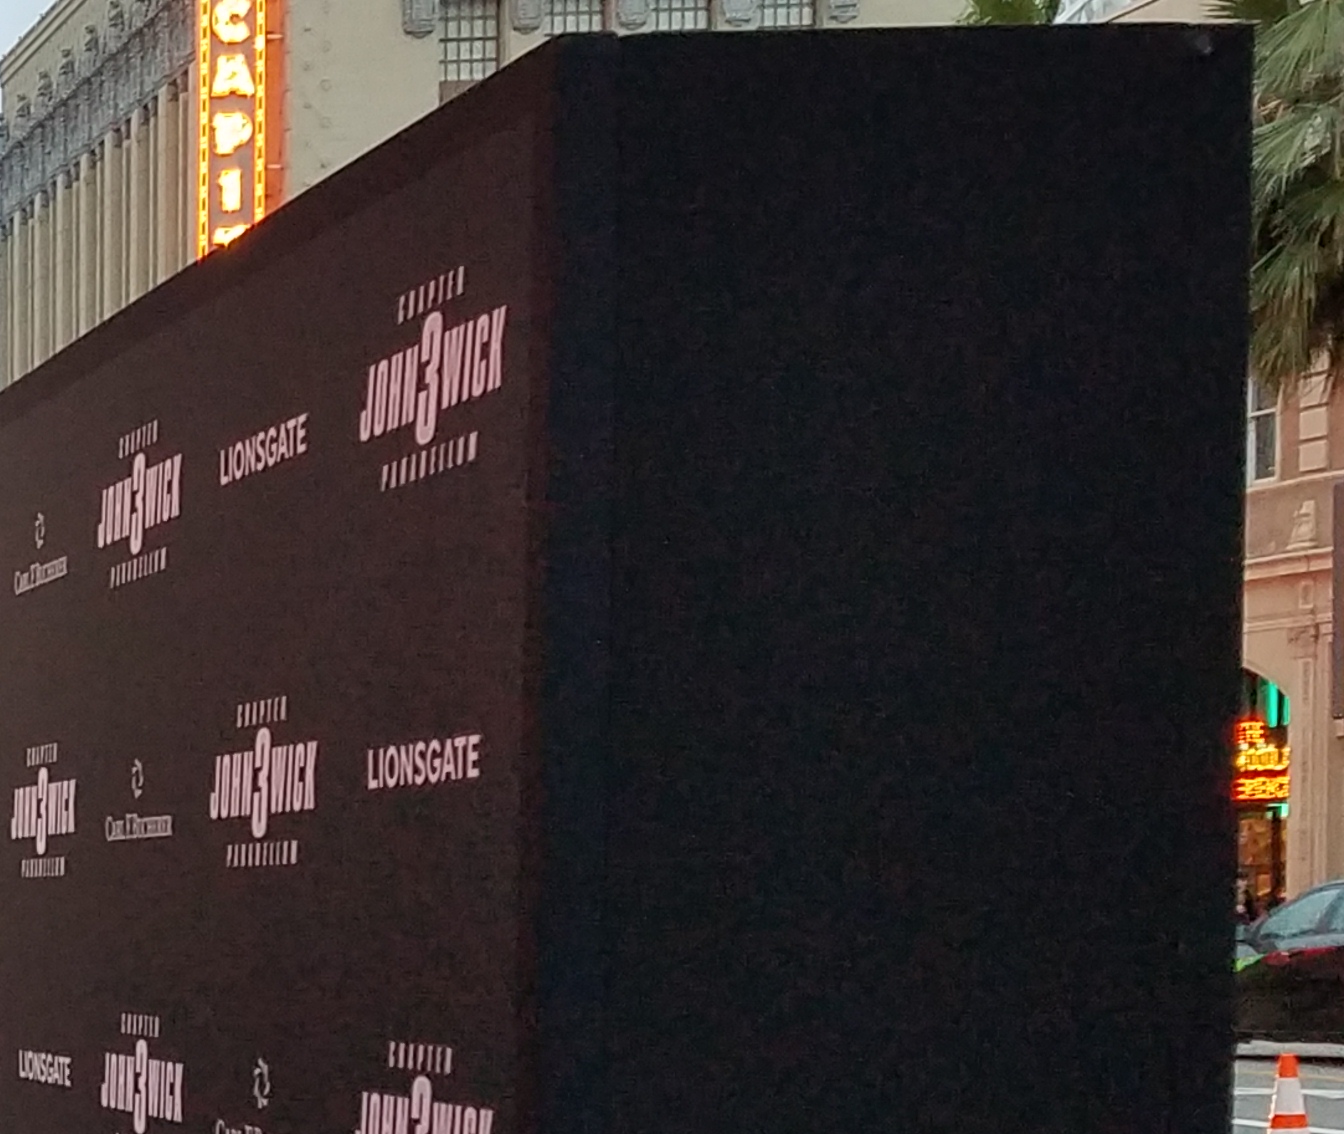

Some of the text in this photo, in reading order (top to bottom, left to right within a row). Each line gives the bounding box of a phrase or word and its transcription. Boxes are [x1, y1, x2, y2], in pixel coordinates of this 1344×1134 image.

[359, 306, 505, 445] JOHN 3 WICK
[220, 413, 306, 485] LIONSGATE
[97, 452, 181, 554] JOHN 3 WICK
[209, 727, 316, 837] JOHN 3 WICK
[368, 734, 480, 788] LIONSGATE
[10, 767, 75, 853] JOHN 3 WICK
[19, 1049, 70, 1086] LIONSGATE
[100, 1039, 182, 1134] JOHN 3 WICK
